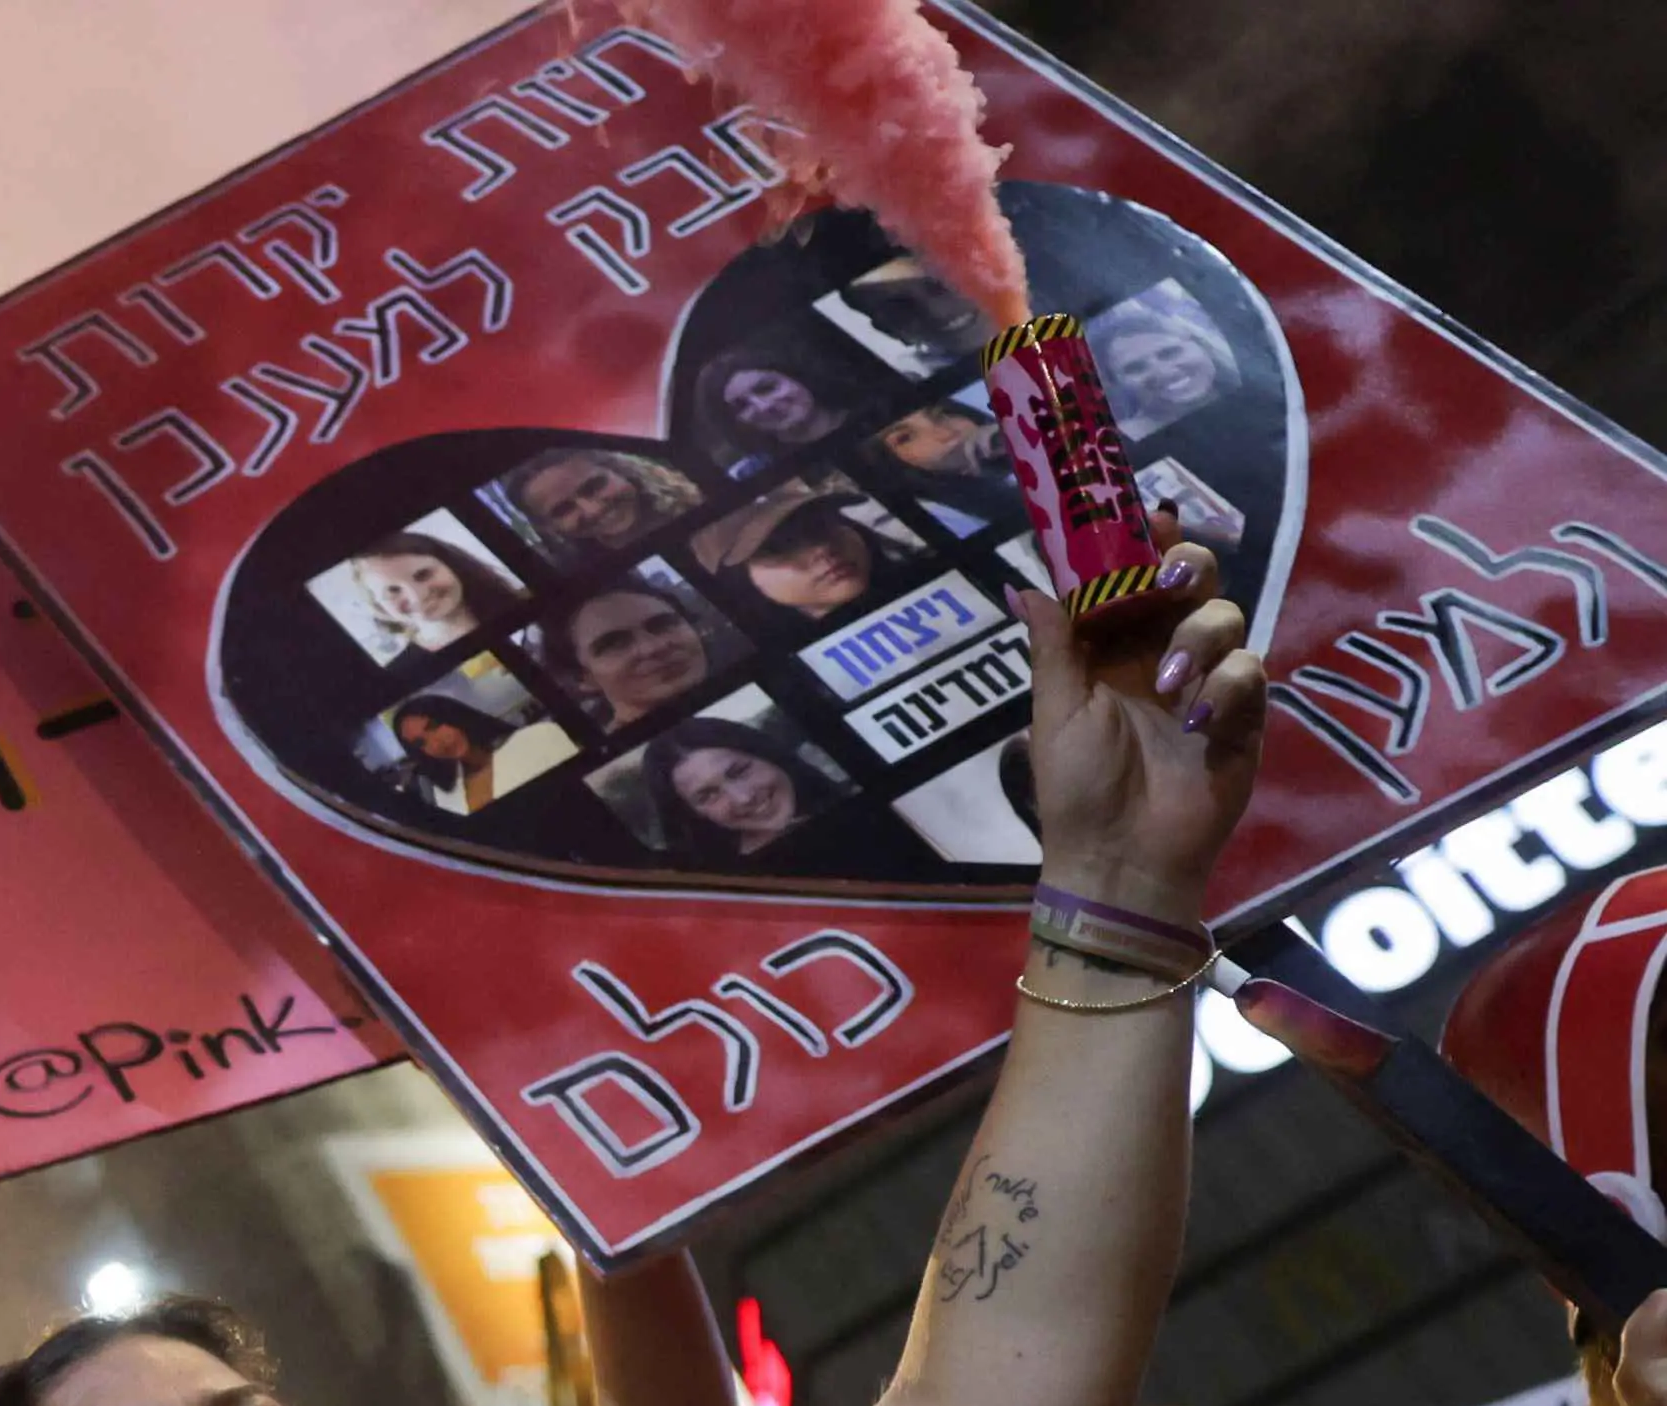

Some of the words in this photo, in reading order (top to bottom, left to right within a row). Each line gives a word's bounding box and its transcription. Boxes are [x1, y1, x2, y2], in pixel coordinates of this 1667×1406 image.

[421, 25, 709, 201] חיות
[16, 185, 348, 421] יקרות
[62, 246, 513, 559] למענכן
[823, 587, 976, 689] ניצחון
[872, 636, 1032, 749] למדינה
[519, 928, 915, 1180] כולם
